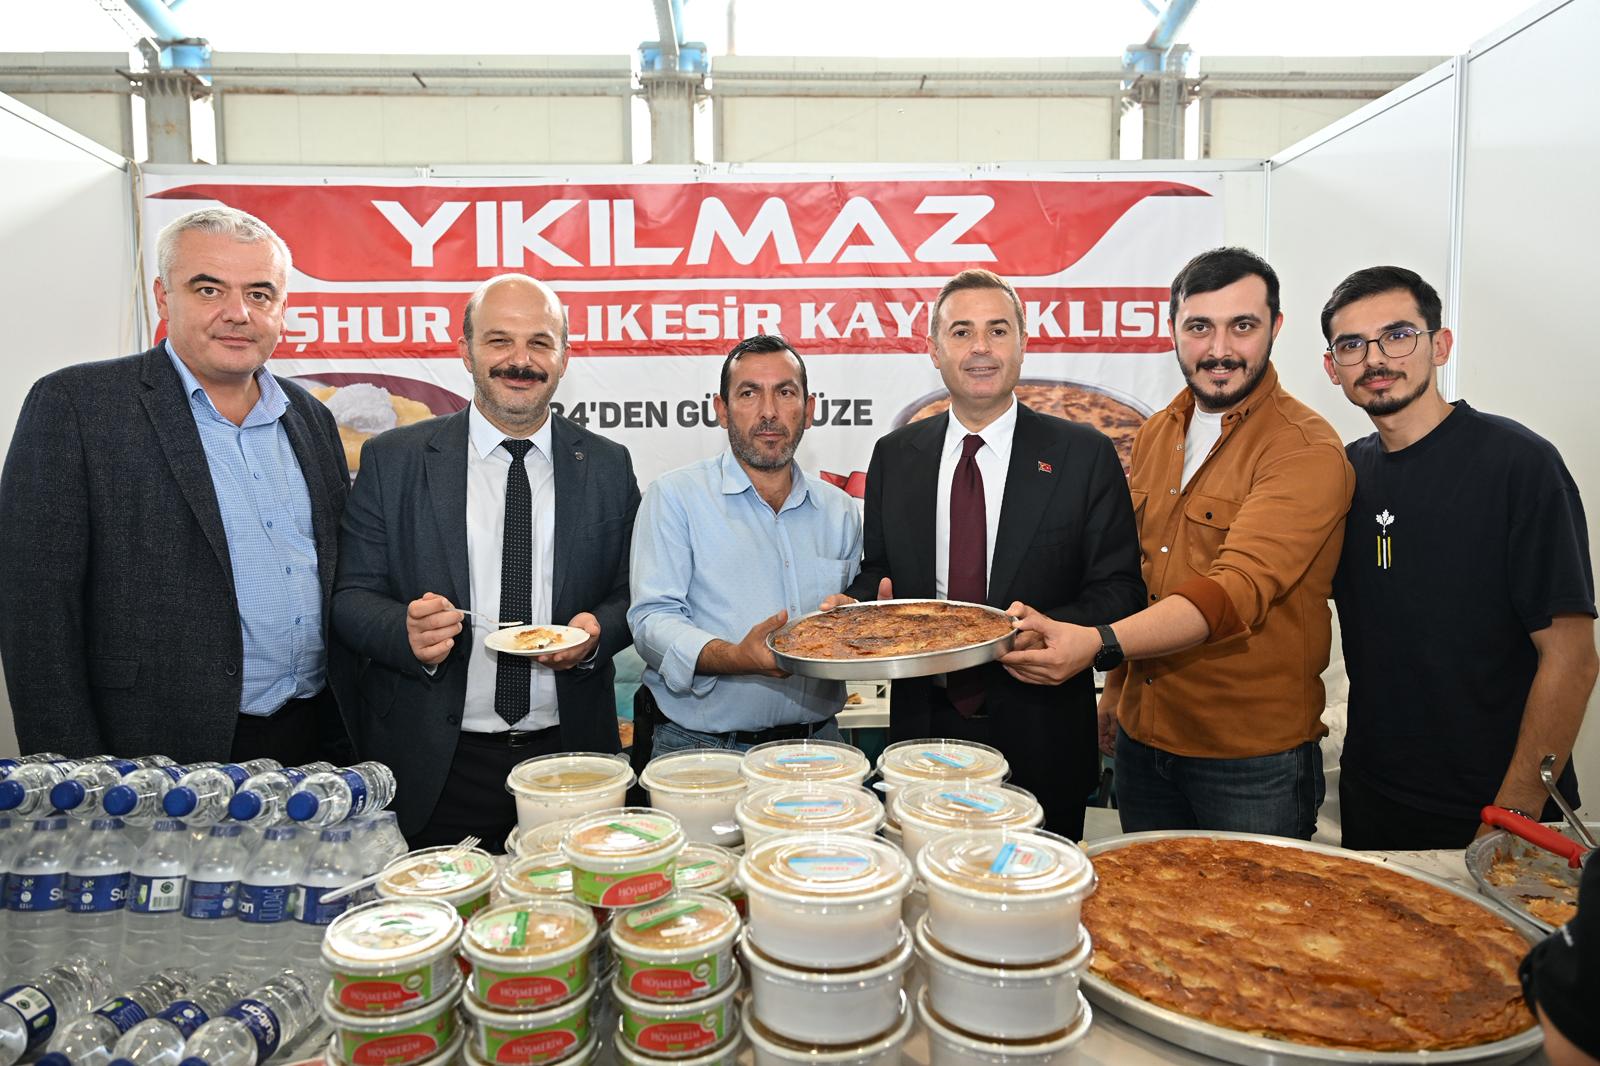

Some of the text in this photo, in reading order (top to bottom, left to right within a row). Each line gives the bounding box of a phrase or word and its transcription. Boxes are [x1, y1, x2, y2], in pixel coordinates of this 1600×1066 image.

[371, 195, 998, 268] YIKILMAZ
[283, 305, 452, 352] ŞHUR
[800, 300, 1172, 339] KAYKLISI
[549, 392, 873, 428] 4'DEN GÜÜZE
